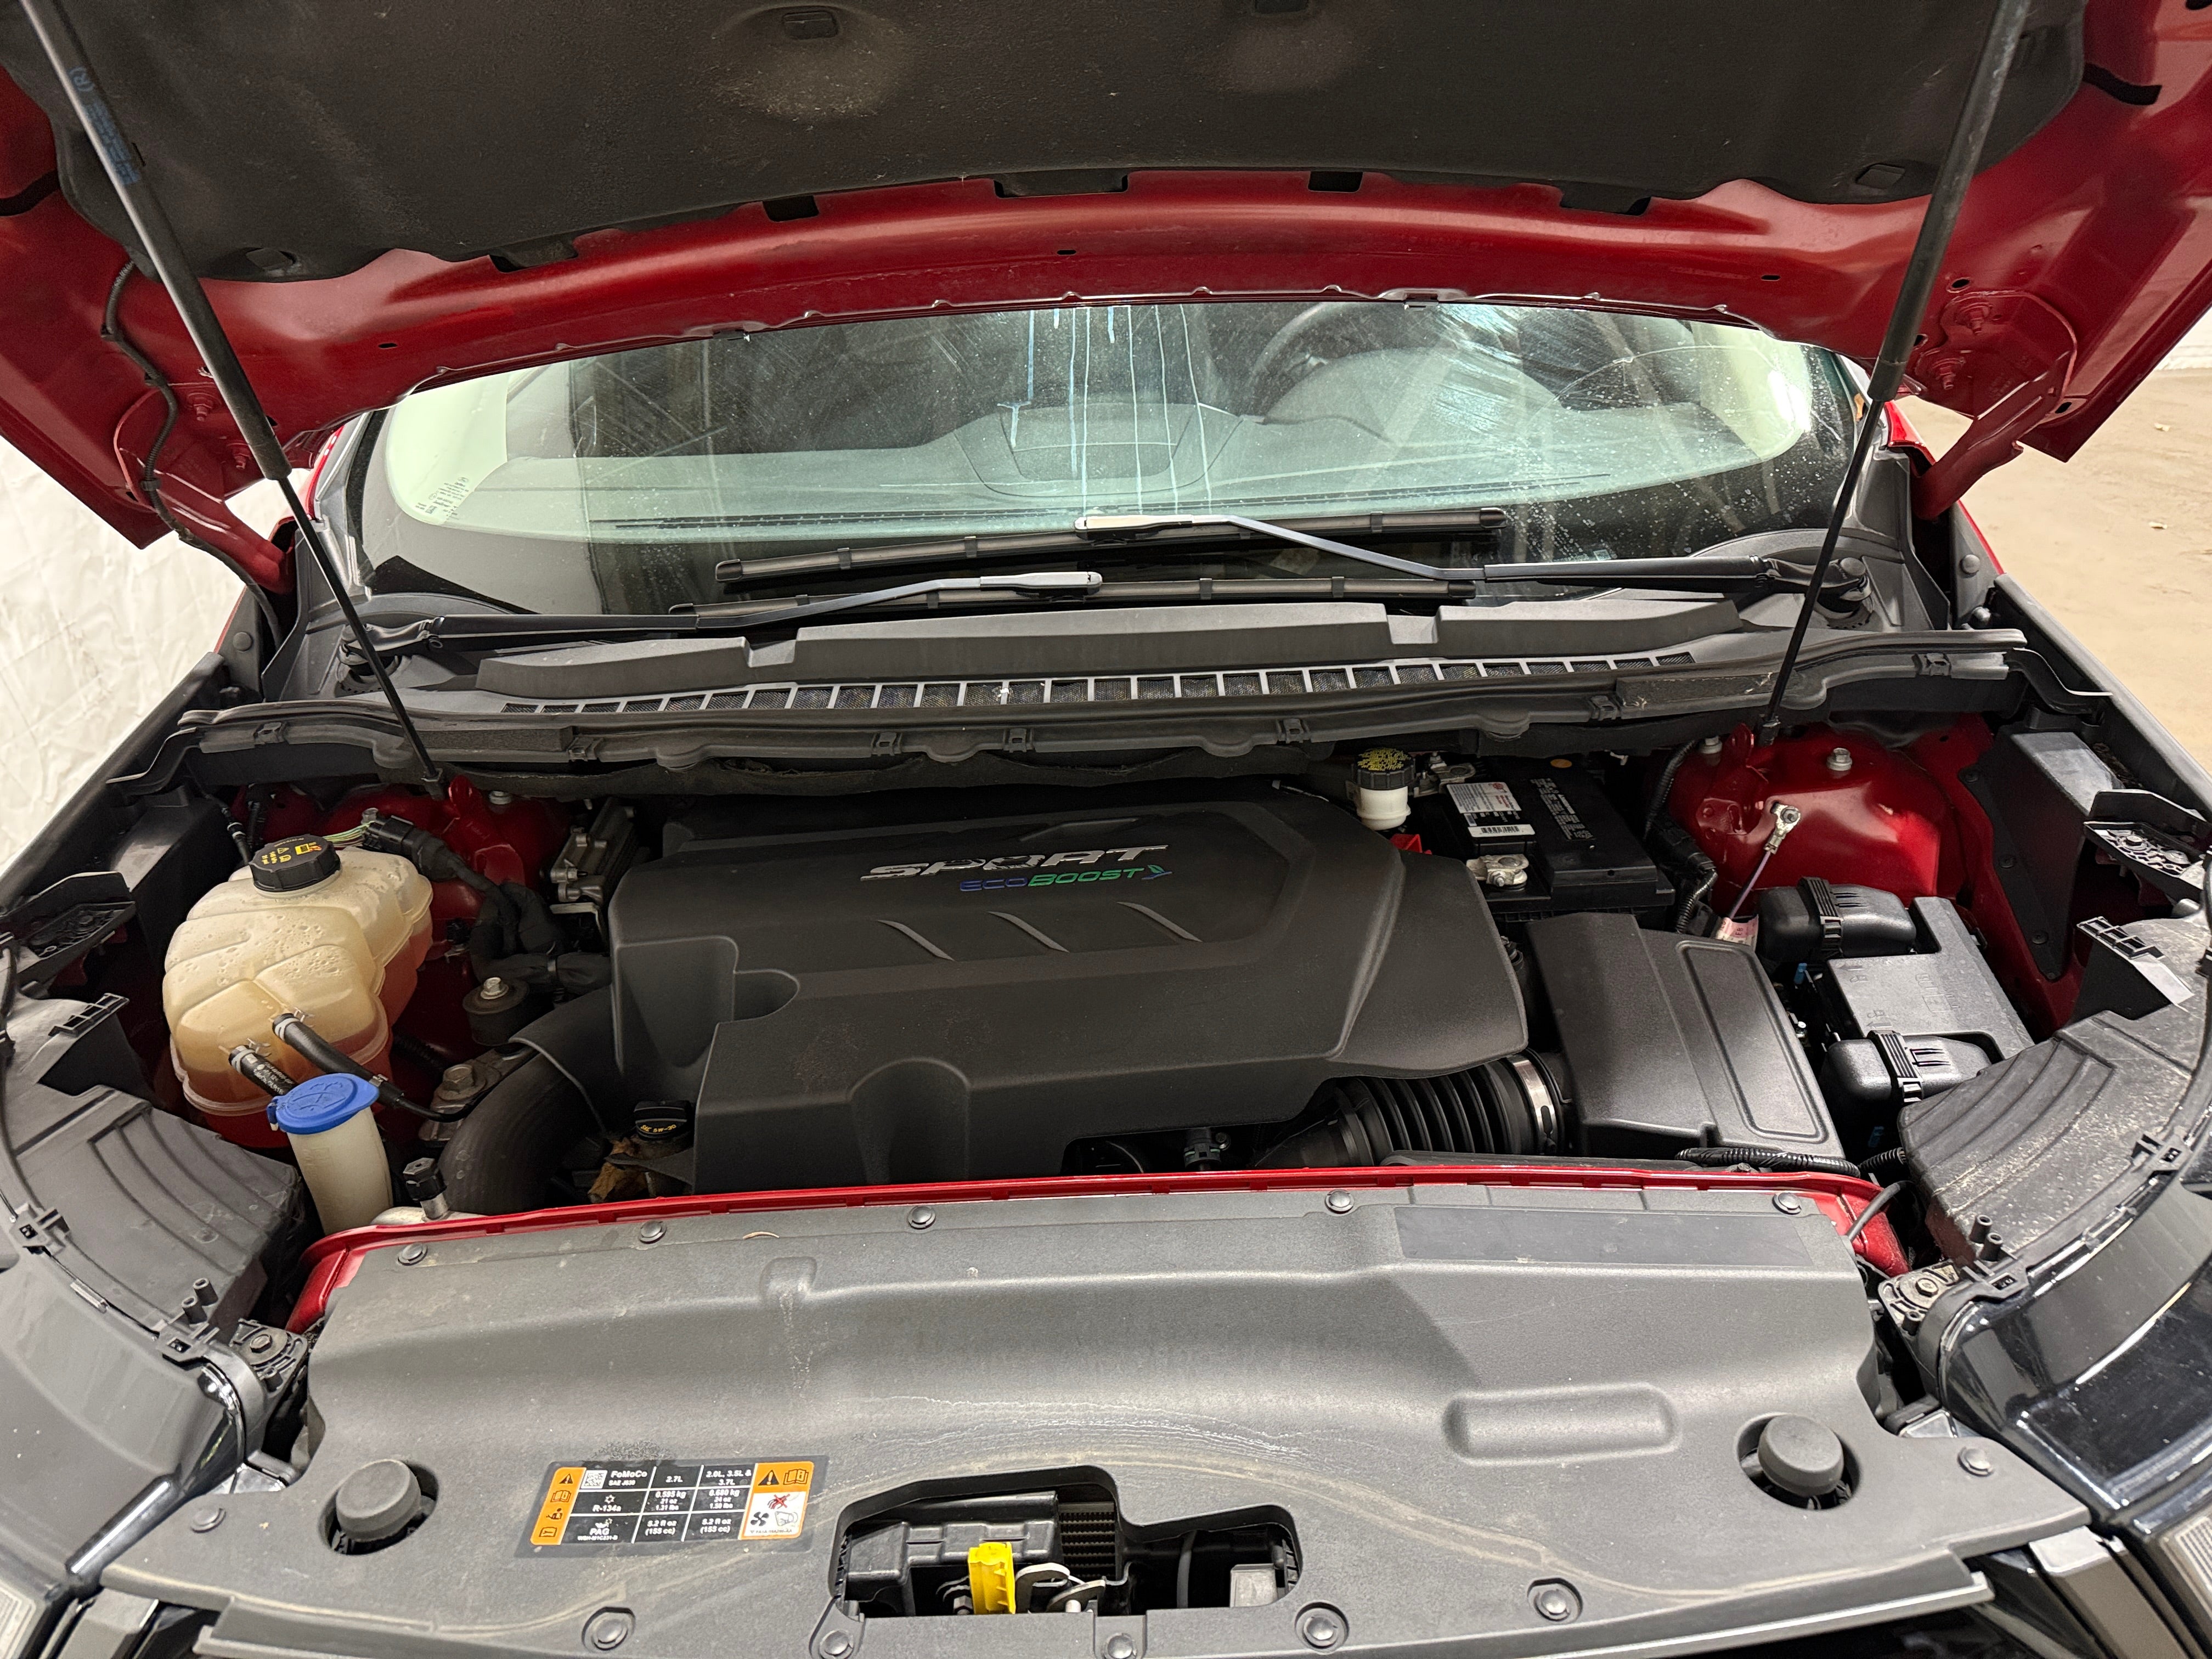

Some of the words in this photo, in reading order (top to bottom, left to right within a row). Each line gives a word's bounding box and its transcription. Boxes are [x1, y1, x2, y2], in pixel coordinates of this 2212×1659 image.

[860, 844, 1169, 882] SPORT
[653, 1124, 677, 1133] 5W-30
[611, 1470, 648, 1479] FoMoCo
[676, 1491, 686, 1499] kg
[730, 1489, 740, 1498] kg
[645, 1528, 662, 1536] (155
[663, 1527, 676, 1536] cc)
[700, 1526, 718, 1534] (155
[718, 1525, 731, 1534] cc)
